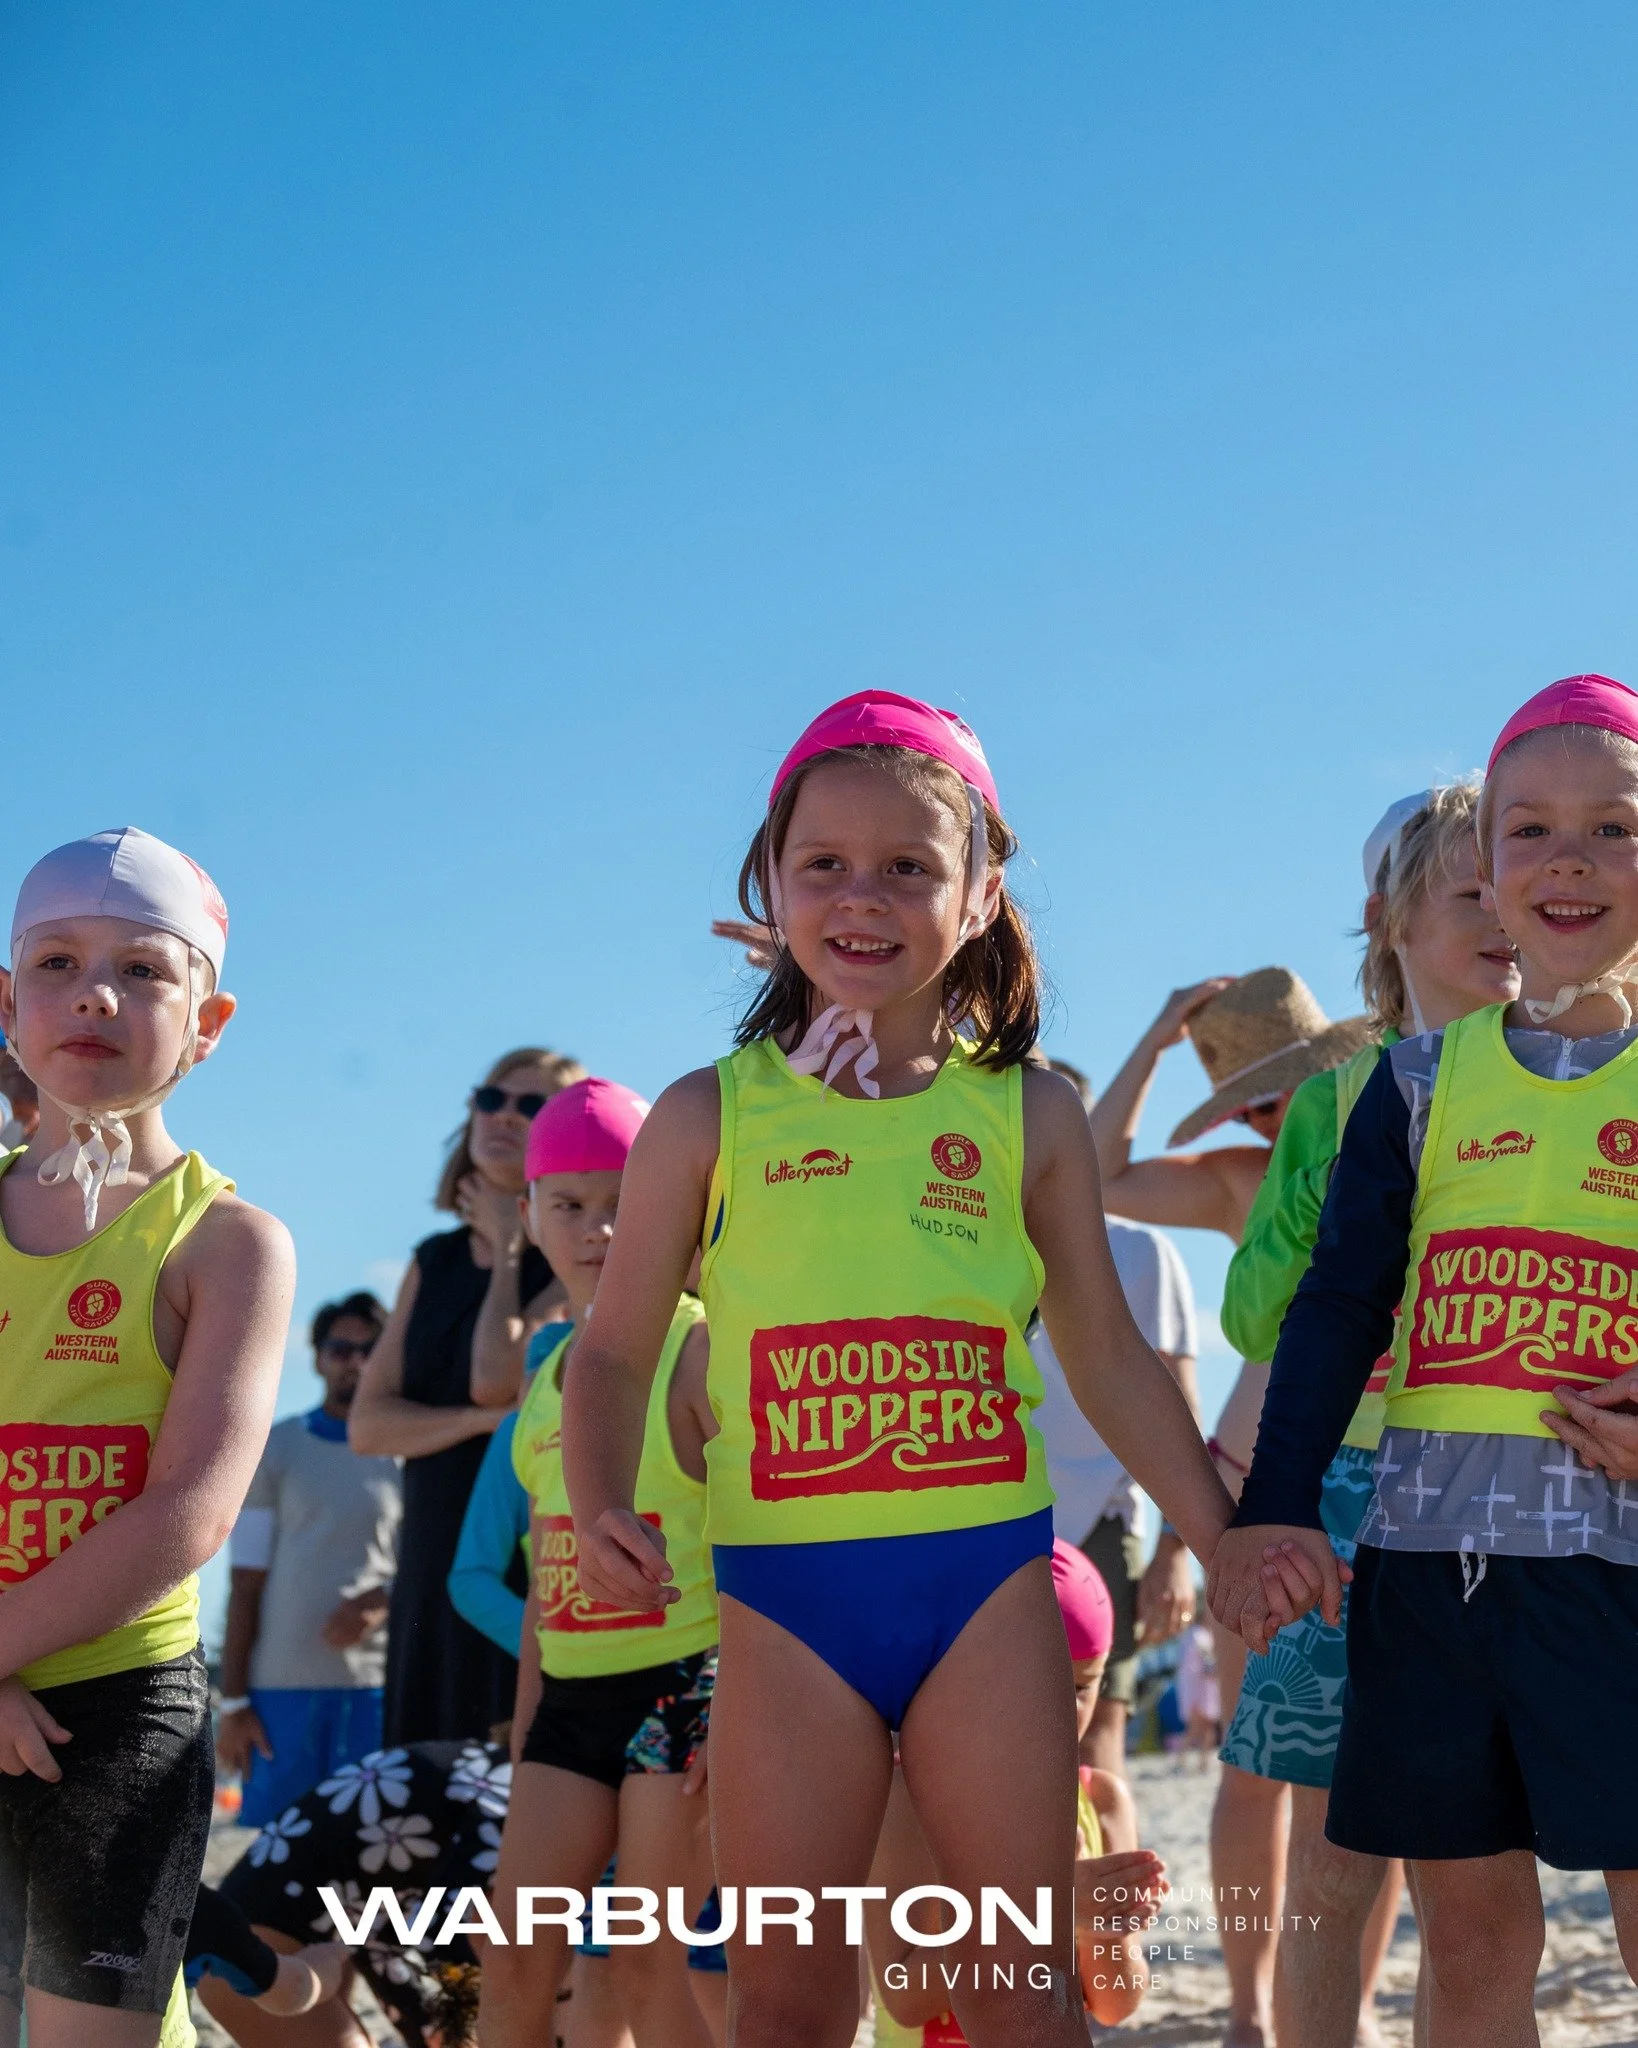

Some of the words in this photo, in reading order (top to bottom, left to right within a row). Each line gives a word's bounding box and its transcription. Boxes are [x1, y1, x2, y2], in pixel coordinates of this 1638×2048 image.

[943, 1134, 972, 1146] SURF
[1457, 1134, 1536, 1163] lotterywest
[765, 1153, 853, 1186] lotterywest
[933, 1153, 949, 1174] LIFE
[950, 1160, 980, 1179] SAVING
[926, 1181, 985, 1204] WESTERN
[919, 1195, 988, 1220] AUSTRALIA
[910, 1213, 978, 1245] HUDSON
[86, 1282, 115, 1292] SURF
[84, 1306, 118, 1328] SAVING
[1420, 1293, 1638, 1364] NIPPERS
[55, 1333, 118, 1349] WESTERN
[44, 1348, 120, 1365] AUSTRALIA
[767, 1340, 992, 1391] WOODSIDE
[766, 1389, 1004, 1456] NIPPERS
[0, 1445, 127, 1492] SIDE
